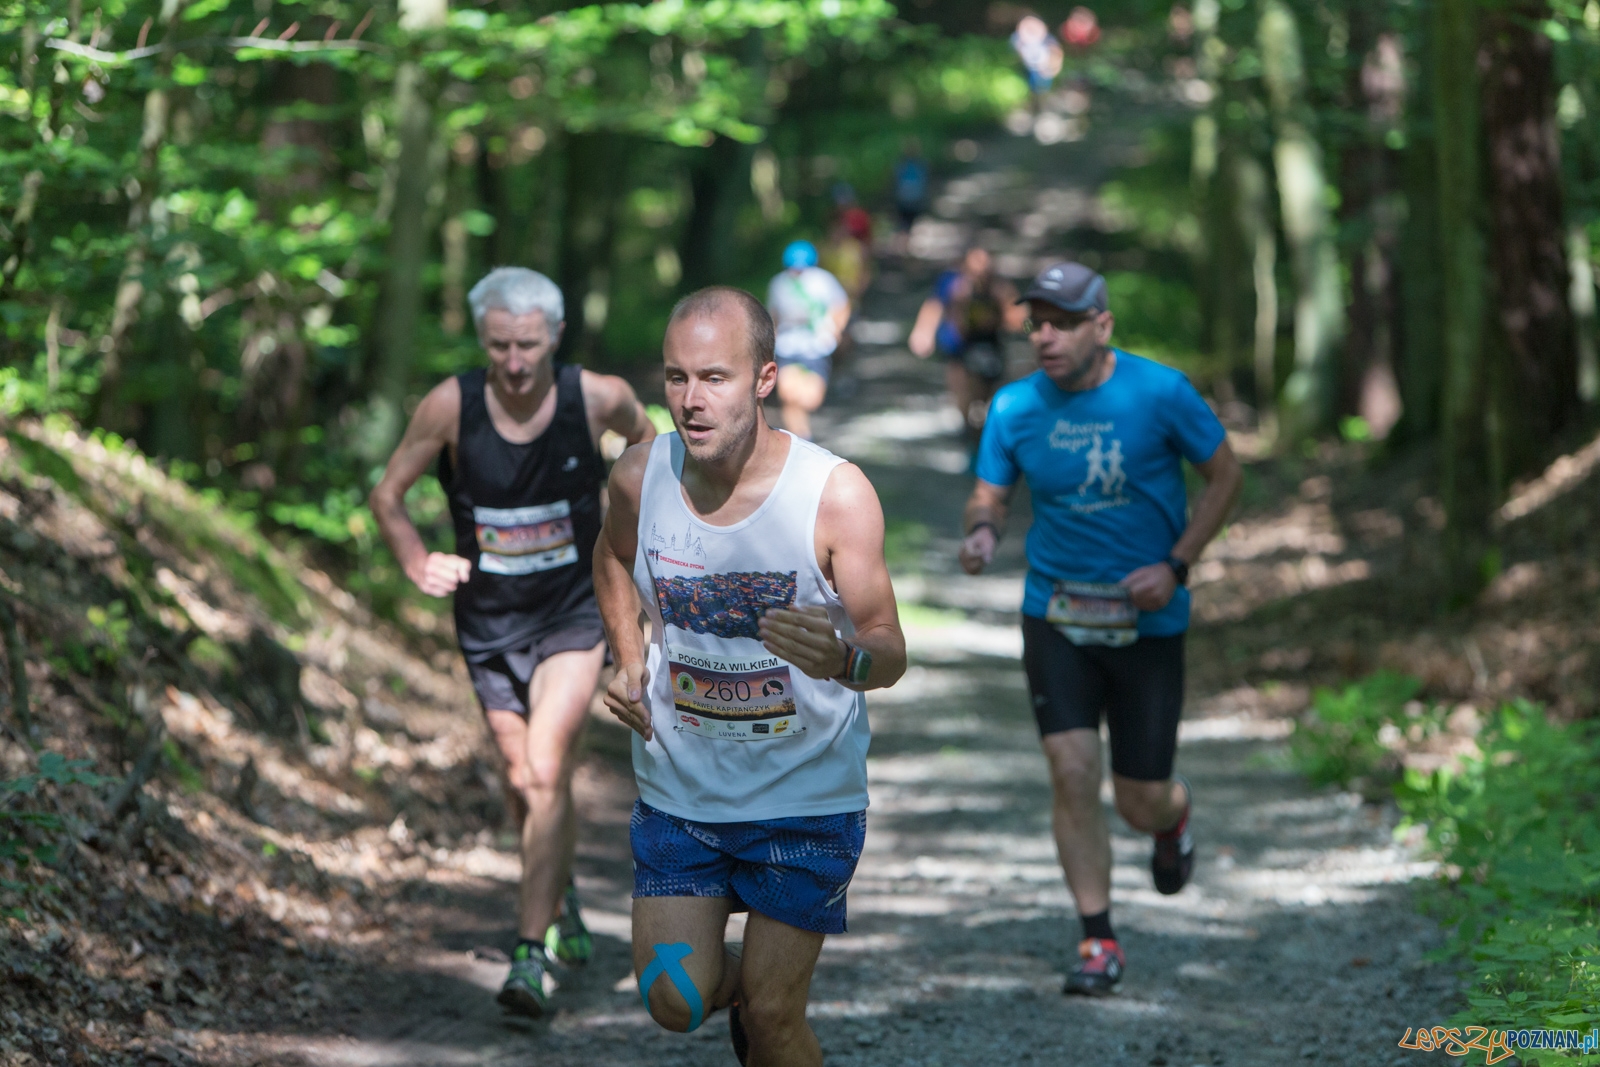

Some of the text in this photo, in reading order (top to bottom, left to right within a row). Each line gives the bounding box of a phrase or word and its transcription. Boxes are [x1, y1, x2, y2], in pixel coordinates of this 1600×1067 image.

[678, 653, 778, 672] POGOŃ ZA WILKIEM
[702, 677, 751, 702] 260
[692, 700, 771, 713] PAWEŁ KAPITAŃCZYK
